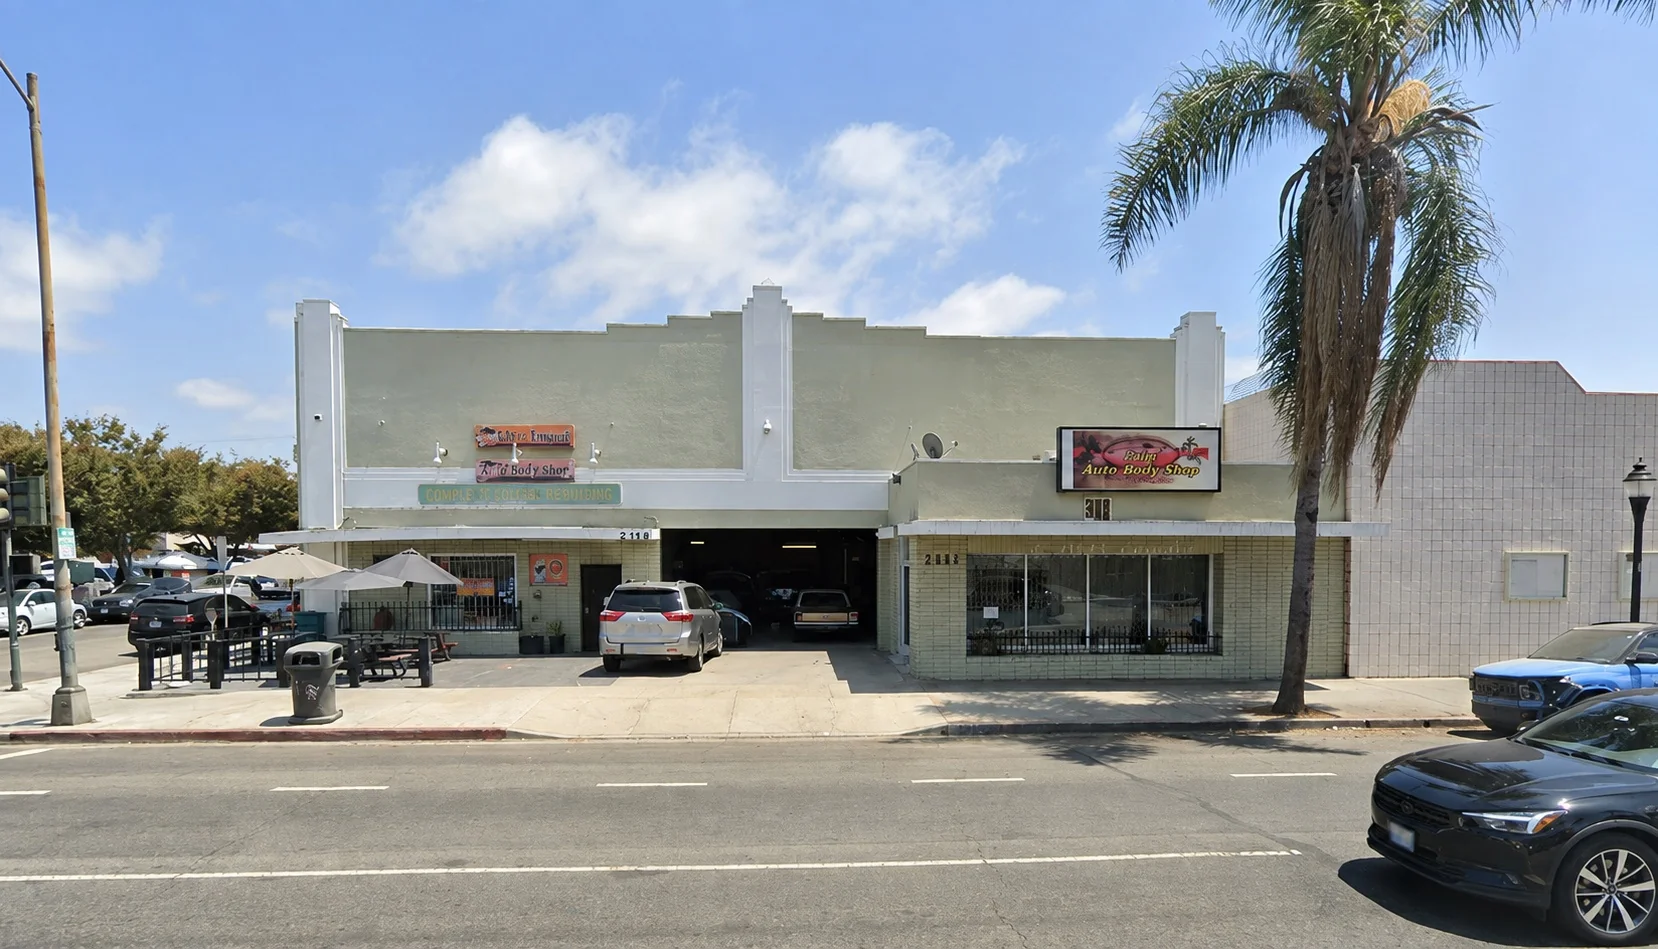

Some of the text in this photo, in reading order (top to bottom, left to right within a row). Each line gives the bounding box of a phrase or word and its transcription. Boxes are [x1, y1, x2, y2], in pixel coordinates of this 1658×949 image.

[511, 463, 539, 477] Body
[1081, 462, 1200, 478] Auto Body Shop
